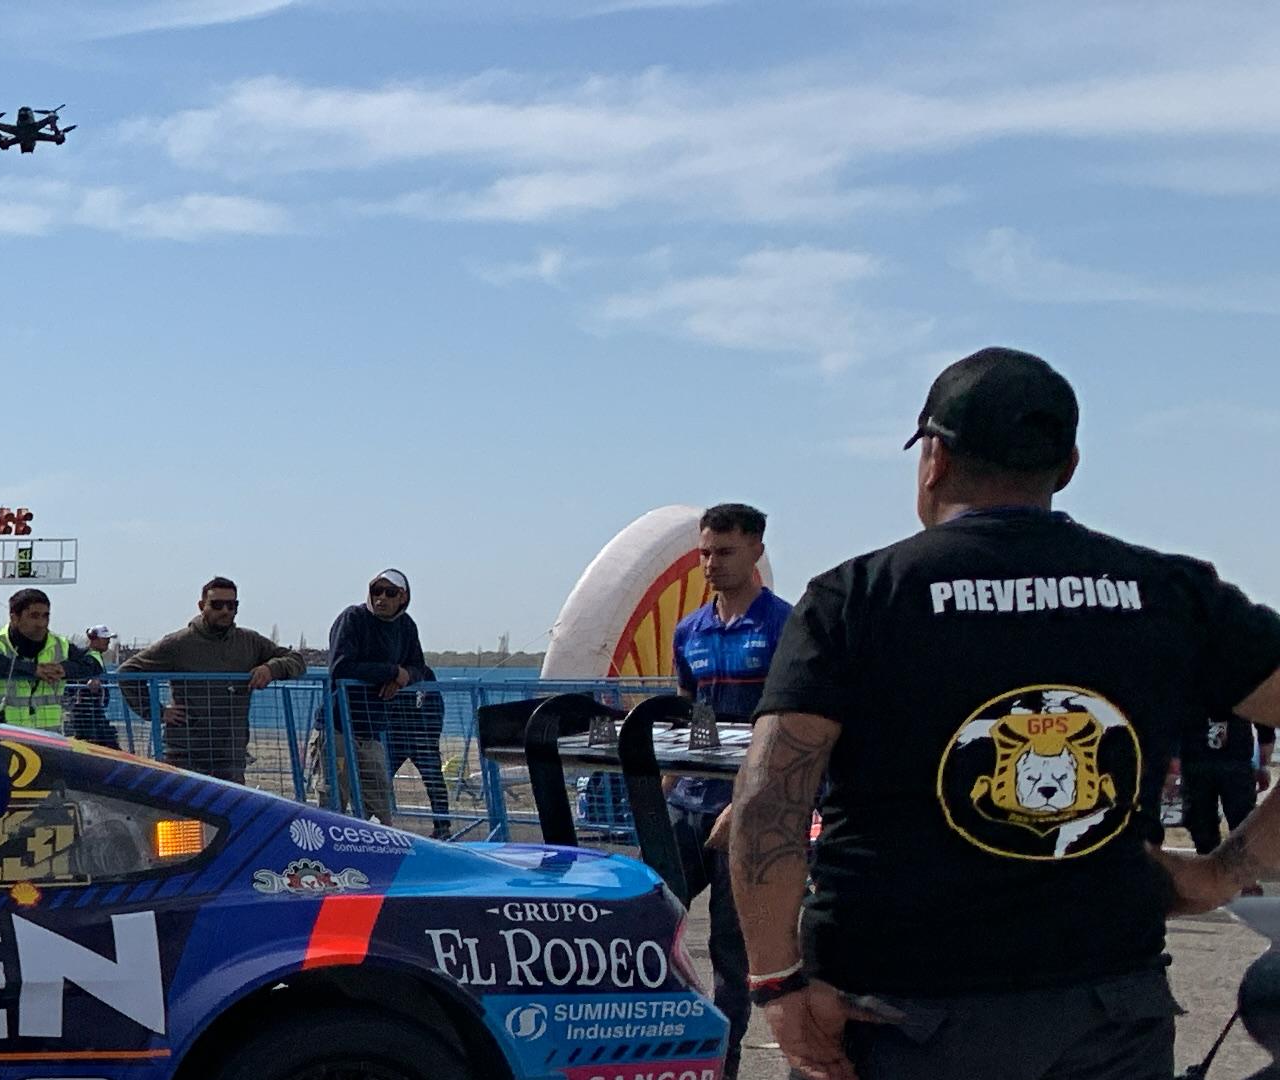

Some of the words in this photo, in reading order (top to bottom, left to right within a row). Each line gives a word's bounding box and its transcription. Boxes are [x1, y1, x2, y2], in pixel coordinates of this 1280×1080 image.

[930, 574, 1142, 613] PREVENCIÓN
[1027, 716, 1070, 736] GPS
[329, 825, 413, 848] cesetti
[503, 902, 599, 922] GRUPO
[425, 928, 496, 986] EL
[499, 928, 668, 988] RODEO
[553, 1000, 705, 1022] SUMINISTROS
[566, 1021, 686, 1040] Industriales
